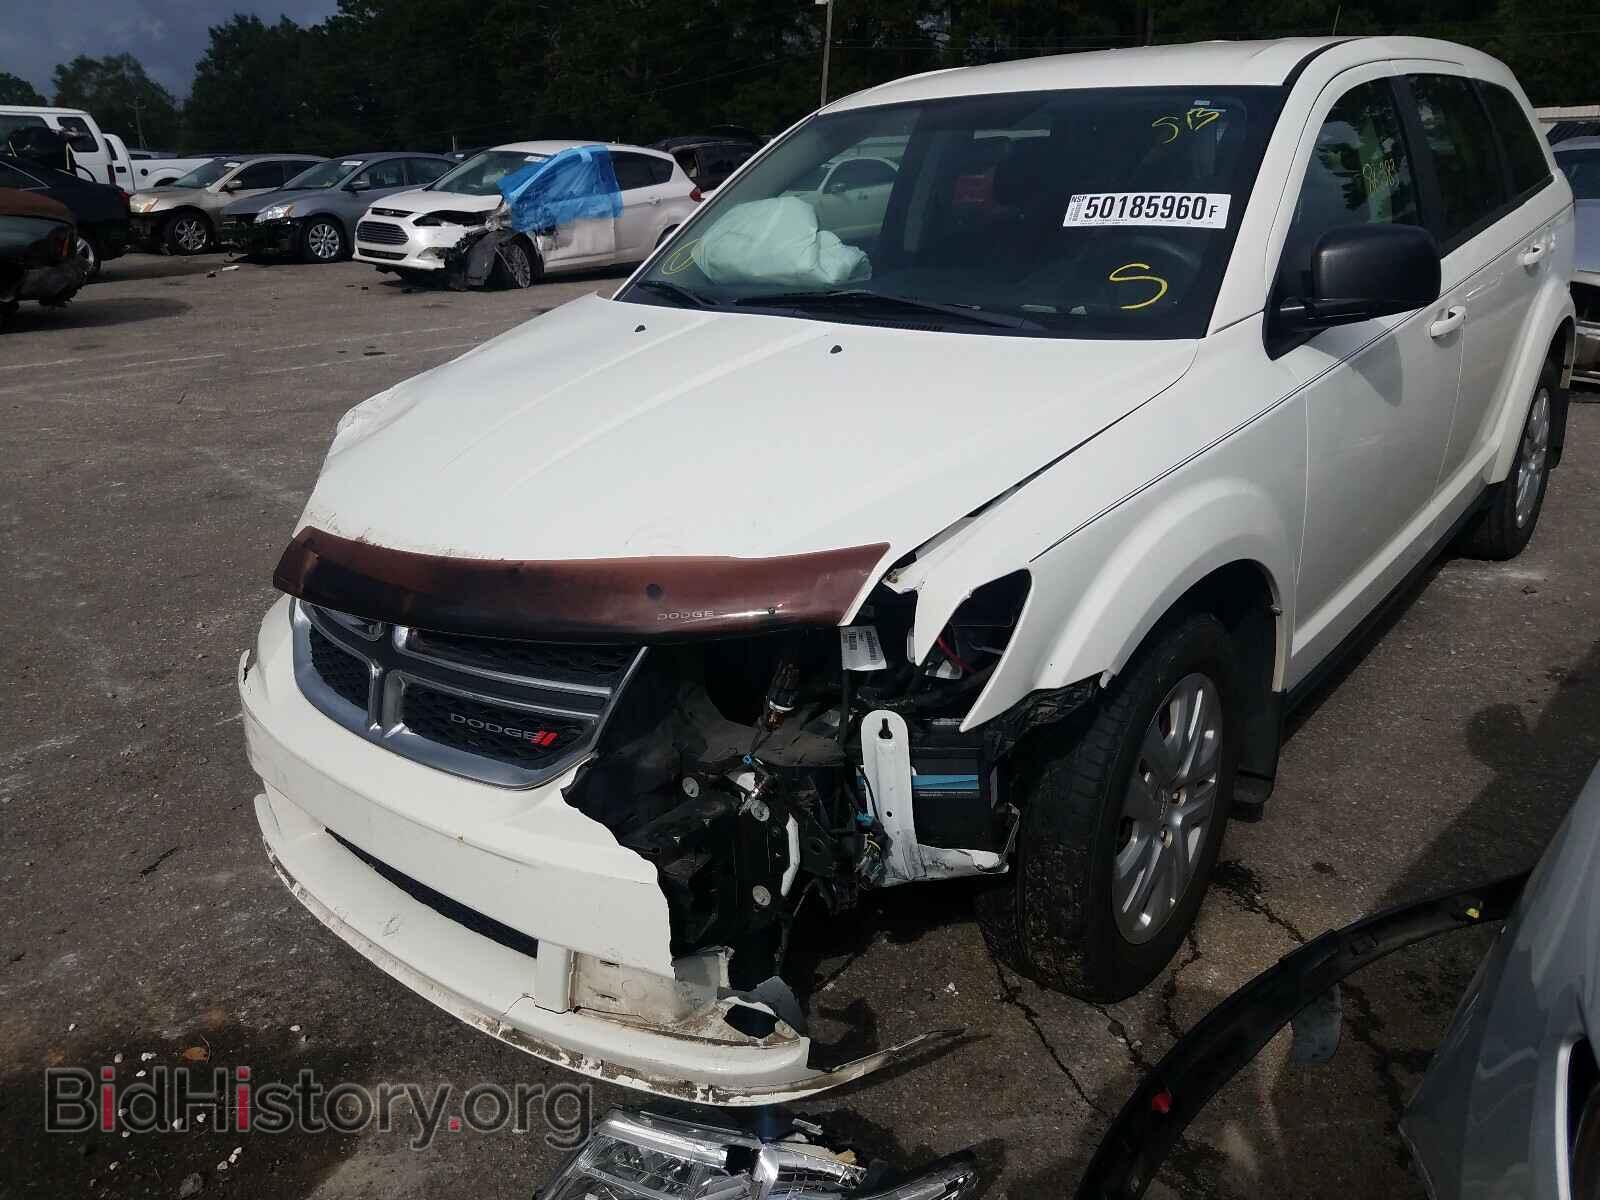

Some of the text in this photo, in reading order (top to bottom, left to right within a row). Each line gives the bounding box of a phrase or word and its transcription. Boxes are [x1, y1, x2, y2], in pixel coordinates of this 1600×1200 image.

[1084, 195, 1208, 220] 50185960
[1208, 205, 1219, 218] F
[657, 610, 714, 621] DODGE
[450, 712, 537, 741] DODGE
